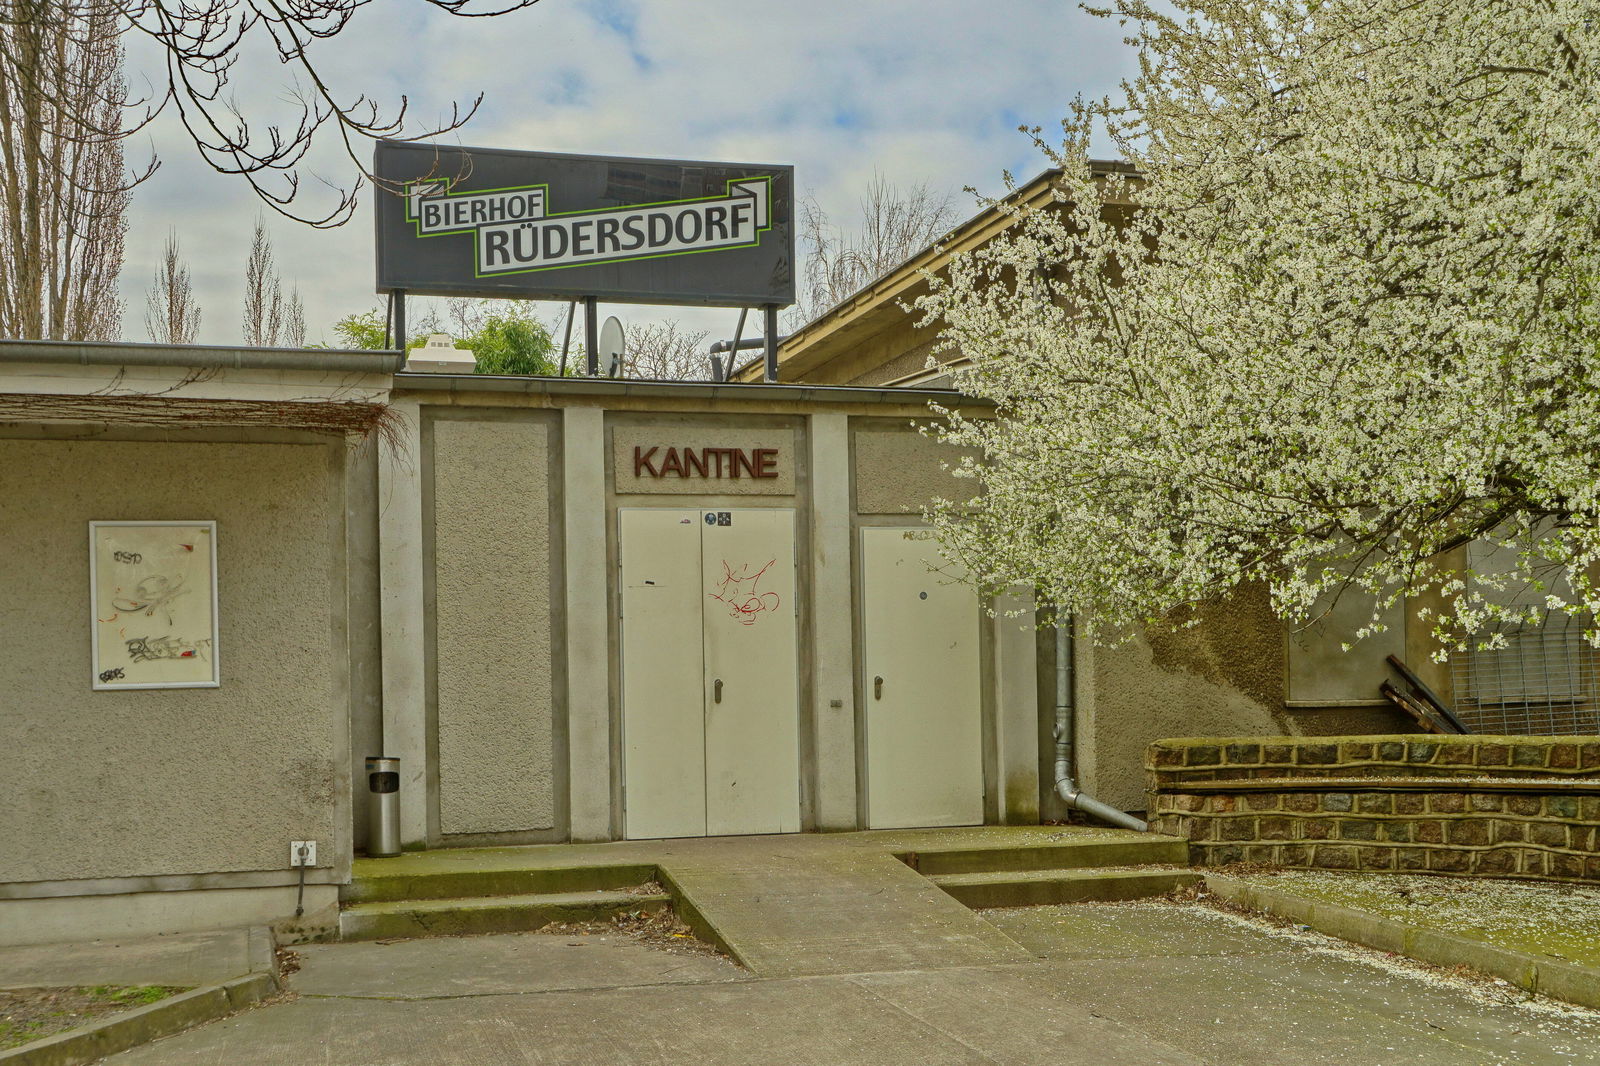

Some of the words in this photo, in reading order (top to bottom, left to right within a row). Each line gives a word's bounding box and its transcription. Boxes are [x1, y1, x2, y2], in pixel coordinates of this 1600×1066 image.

[424, 193, 542, 228] BIERHOF
[485, 203, 752, 266] RÜDERSDORF
[634, 446, 779, 478] KANTINE
